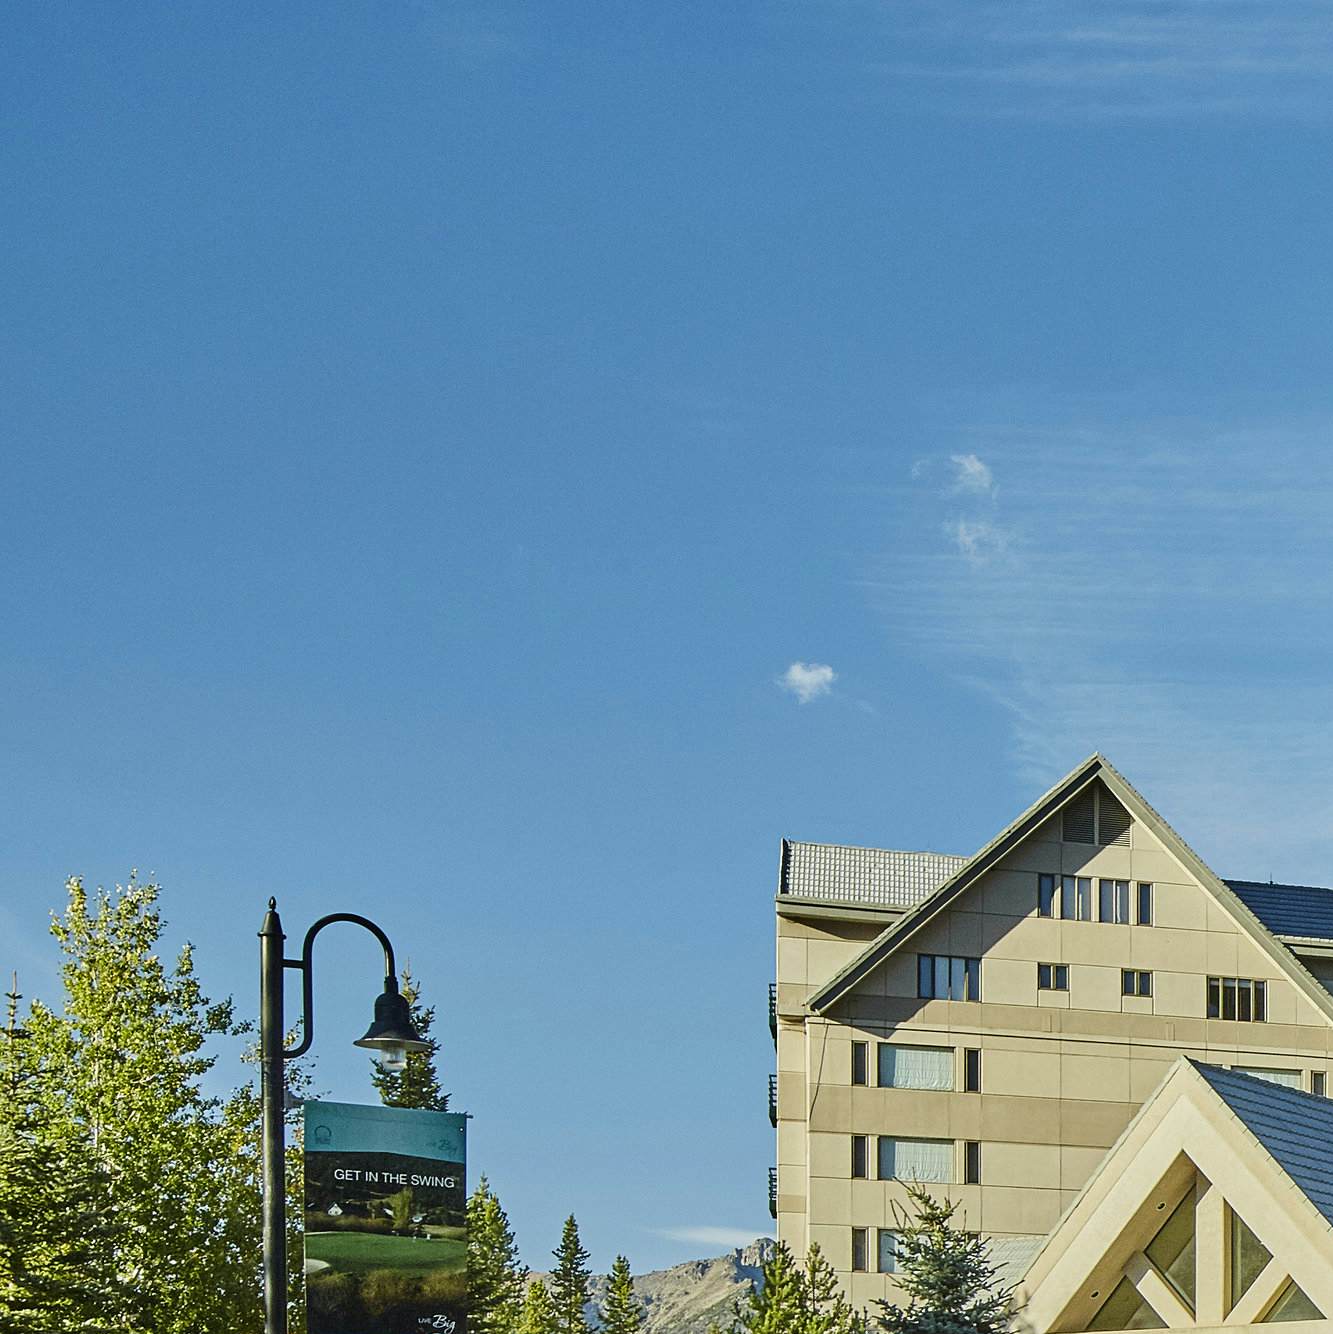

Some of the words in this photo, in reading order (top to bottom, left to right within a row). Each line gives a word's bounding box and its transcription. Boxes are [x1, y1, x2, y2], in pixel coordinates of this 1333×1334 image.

[334, 1168, 361, 1181] GET
[365, 1171, 379, 1183] IN
[382, 1172, 407, 1185] THE
[411, 1174, 455, 1189] SWING
